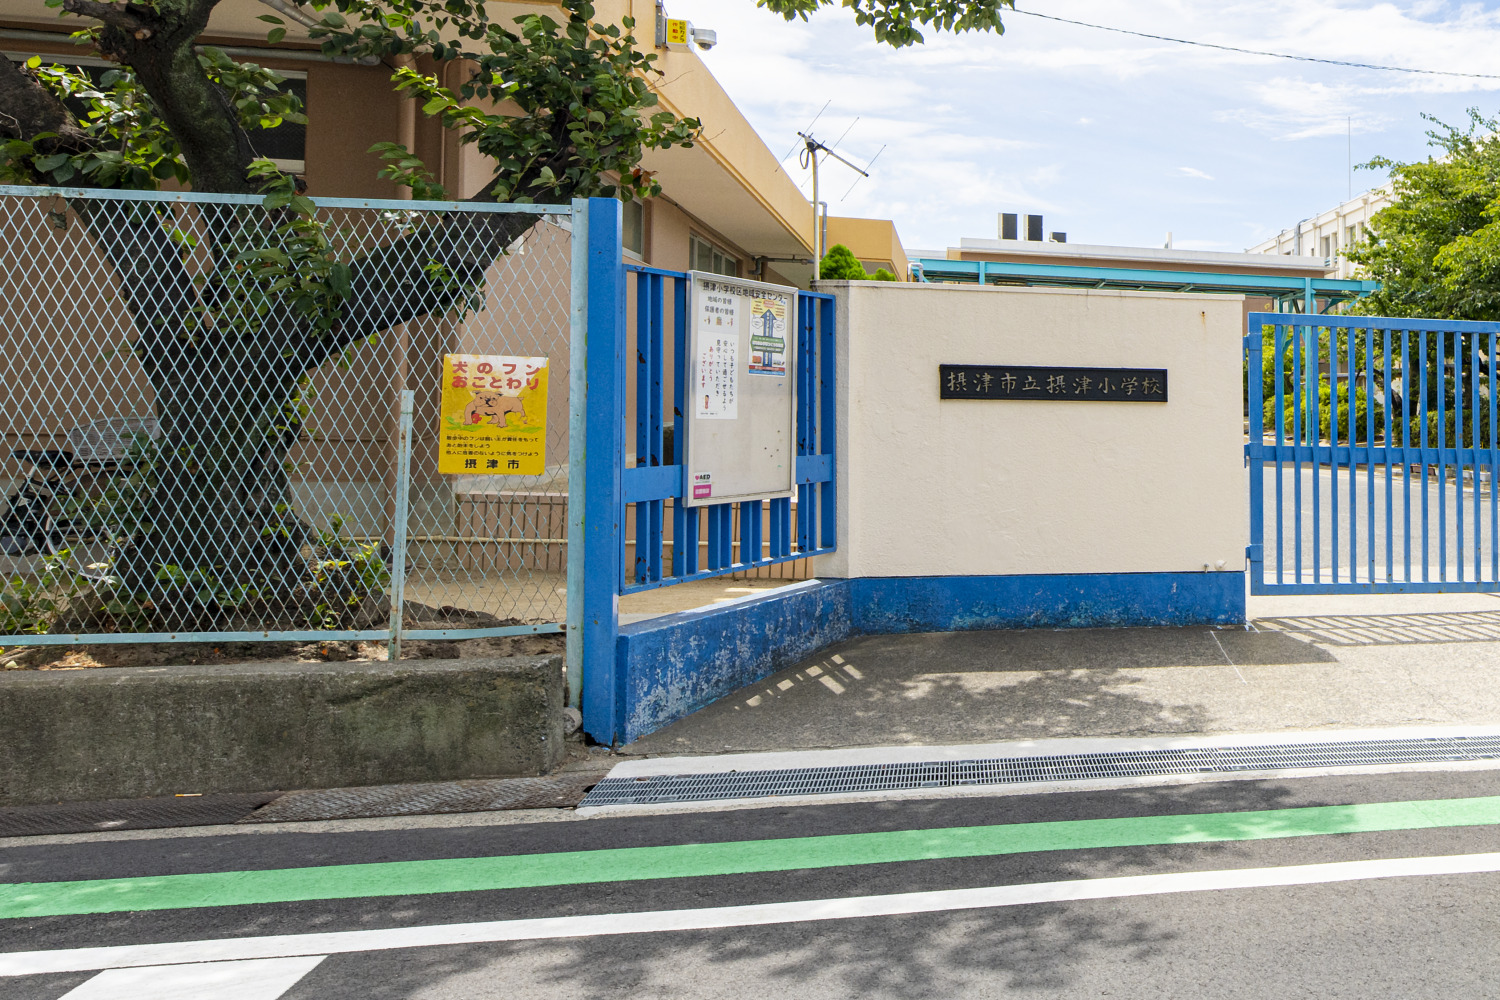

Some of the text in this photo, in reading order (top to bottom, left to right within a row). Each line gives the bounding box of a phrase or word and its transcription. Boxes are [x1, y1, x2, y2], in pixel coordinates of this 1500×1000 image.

[452, 361, 541, 375] 犬のフン
[452, 375, 539, 390] おことわり
[947, 371, 1163, 396] 摂津市立摂津小学校
[465, 459, 520, 469] 摂津市
